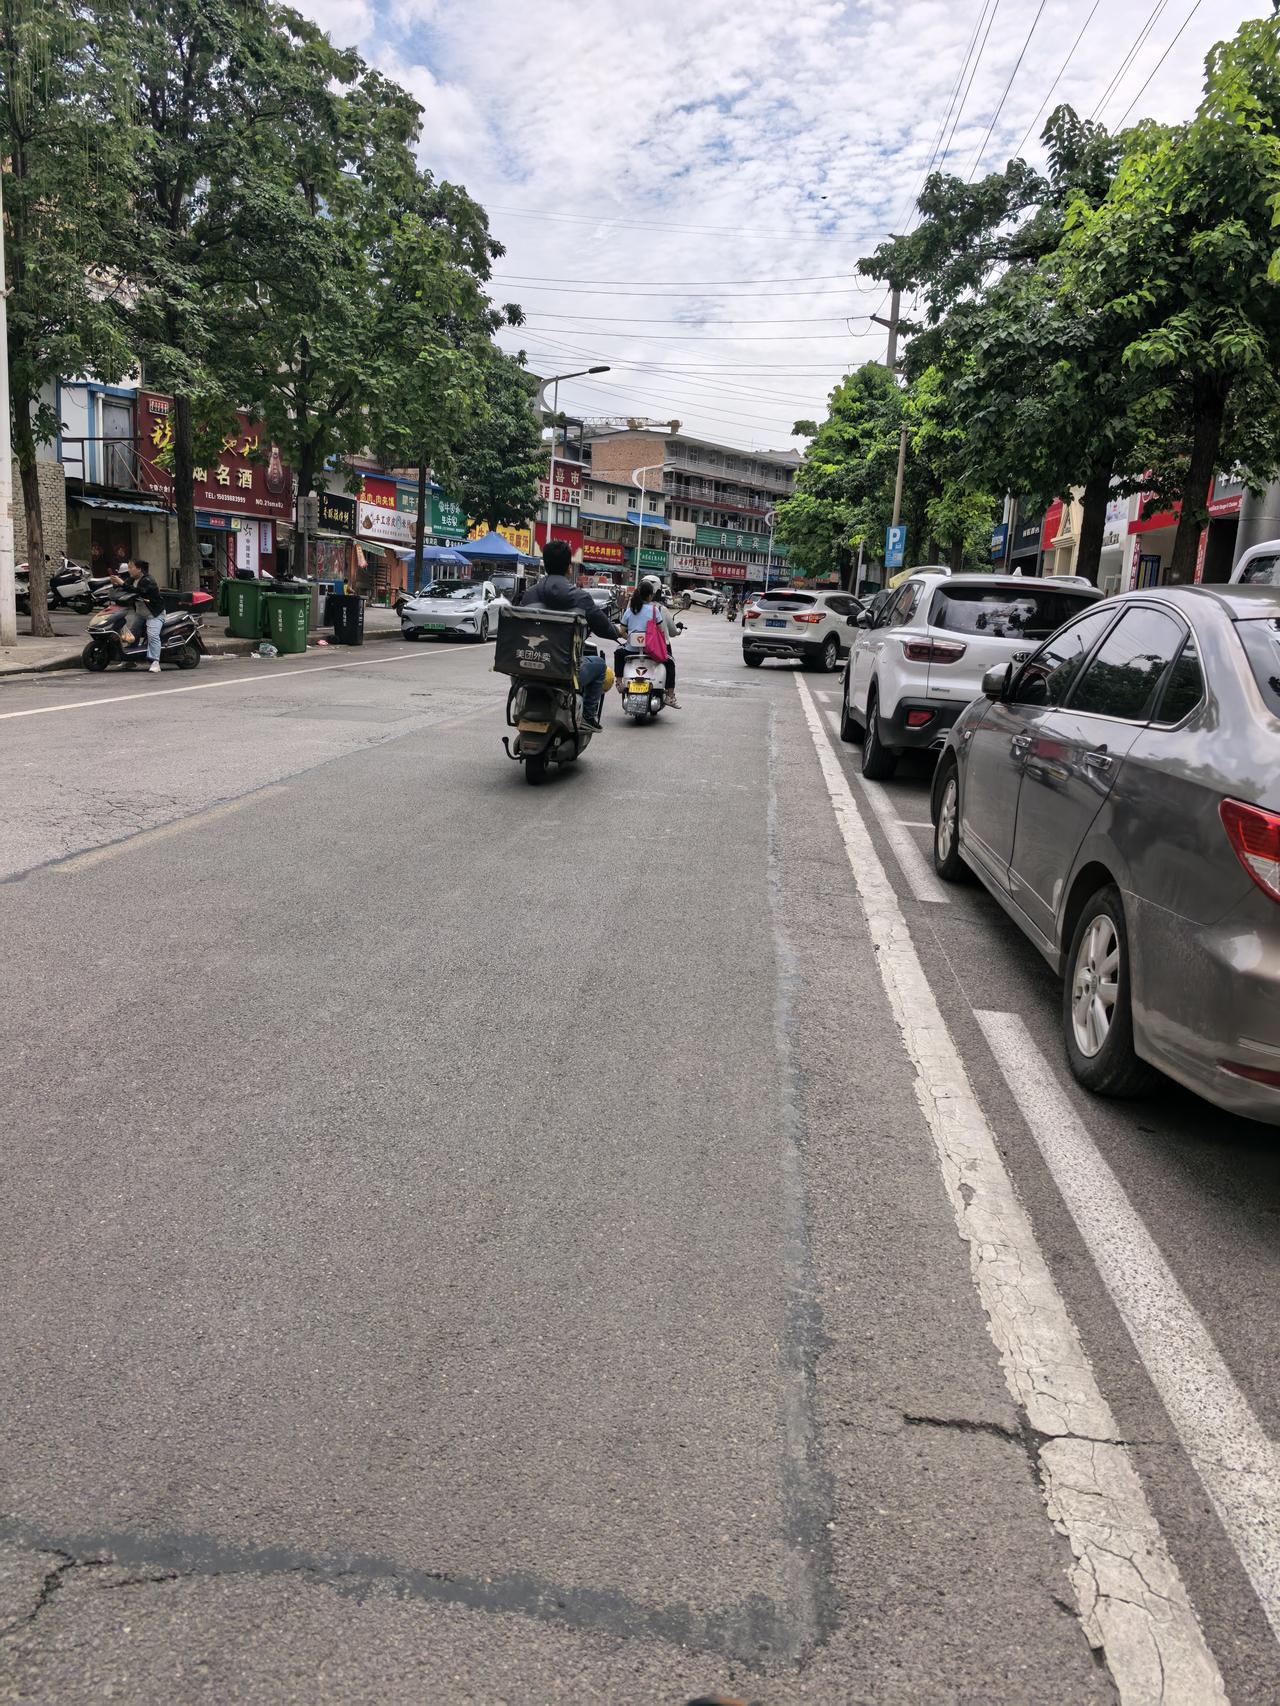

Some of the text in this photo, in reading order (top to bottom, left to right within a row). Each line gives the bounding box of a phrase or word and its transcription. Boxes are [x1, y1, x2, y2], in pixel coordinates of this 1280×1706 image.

[889, 528, 900, 550] P
[516, 649, 551, 662] 美团外卖
